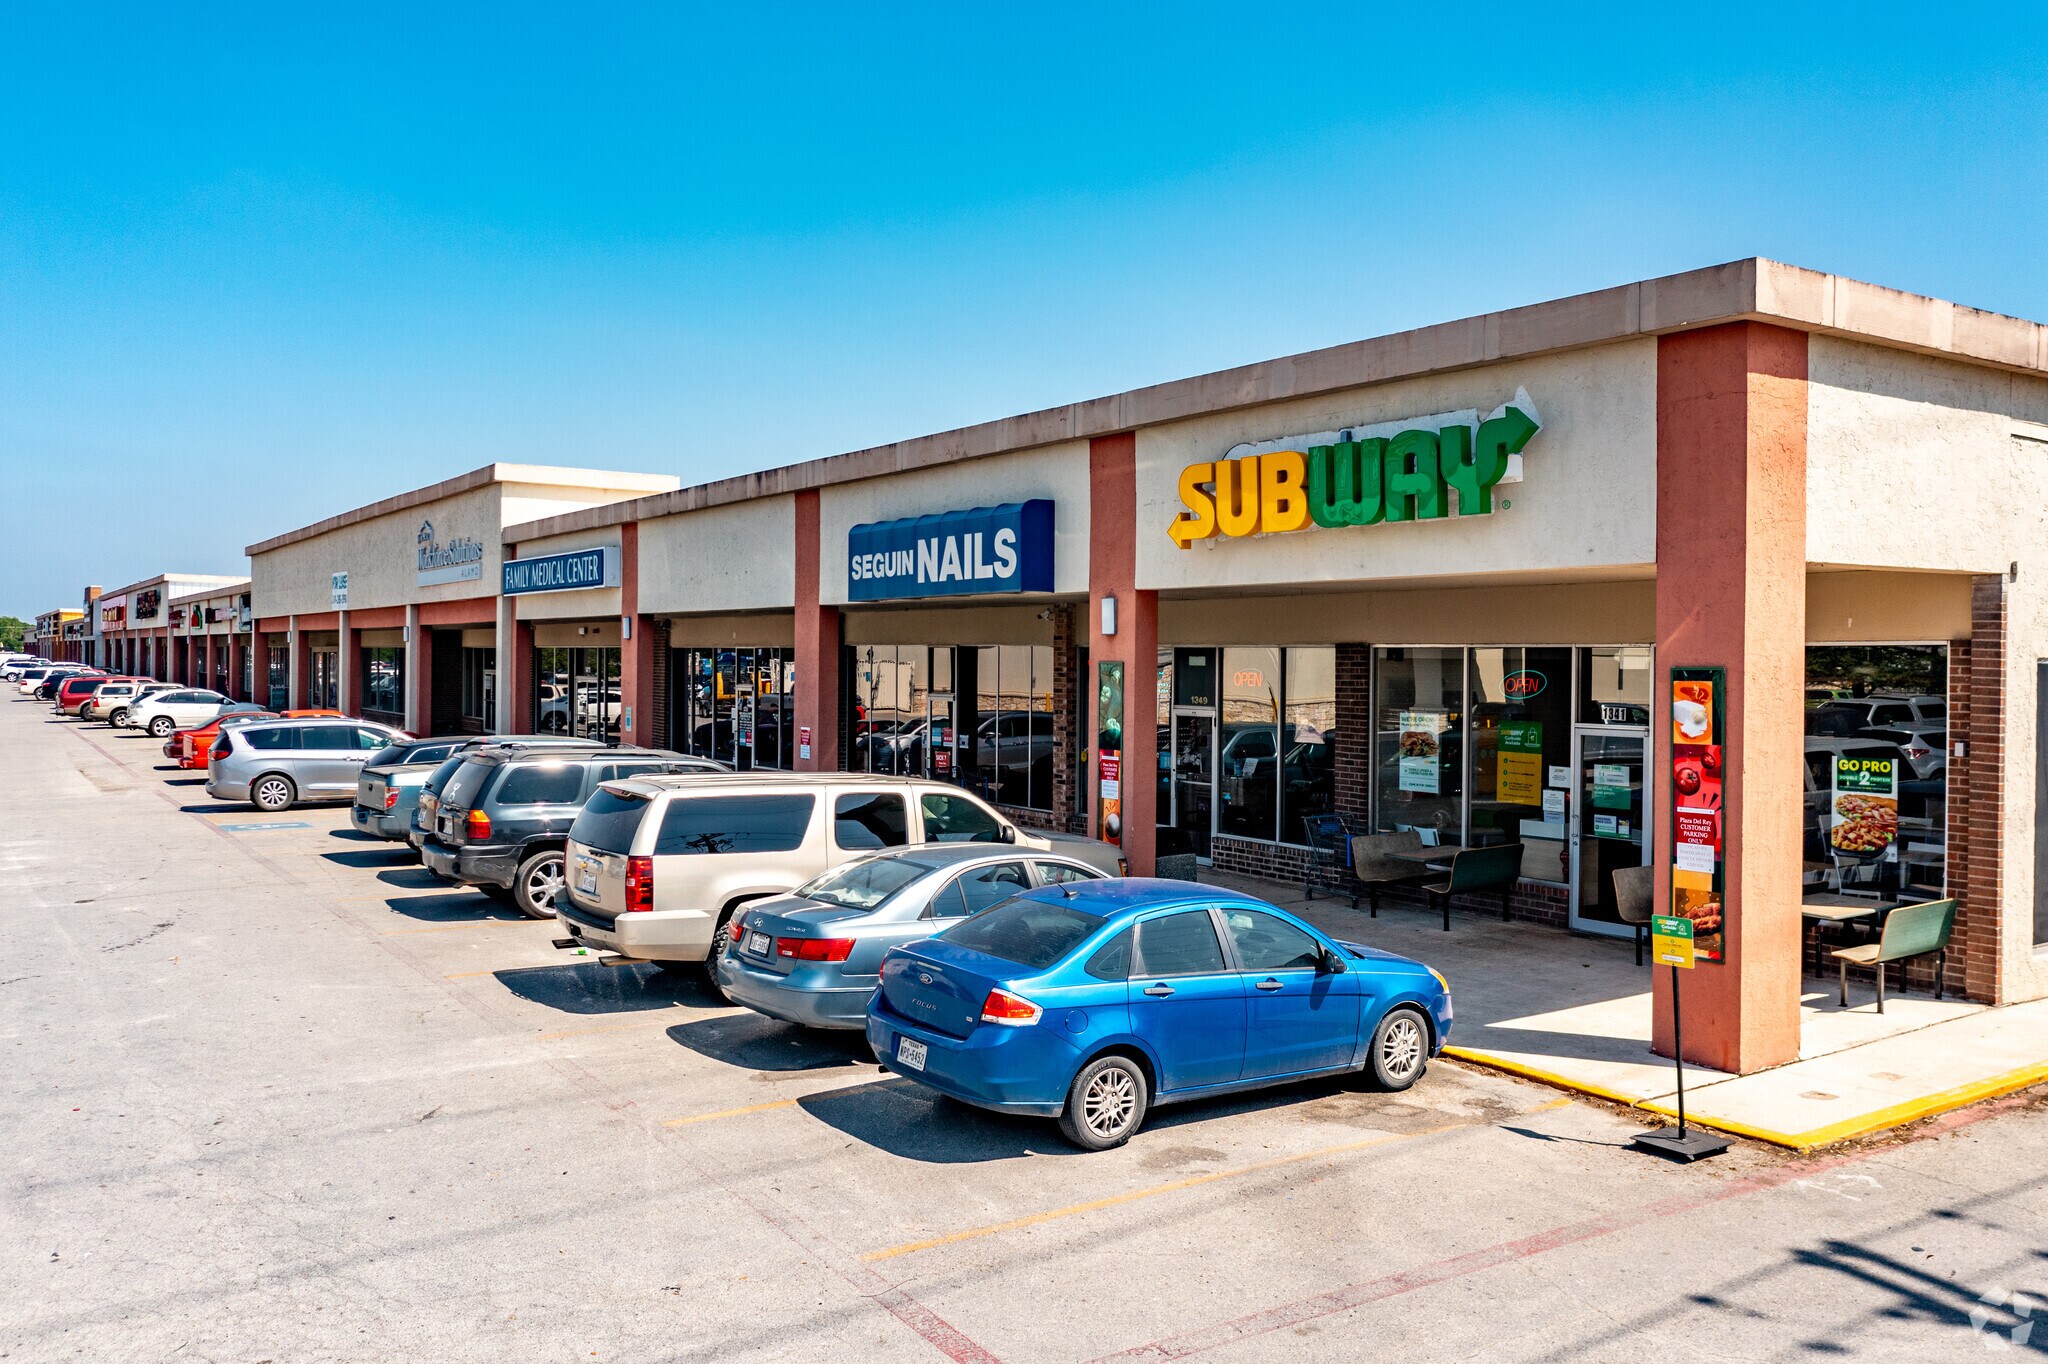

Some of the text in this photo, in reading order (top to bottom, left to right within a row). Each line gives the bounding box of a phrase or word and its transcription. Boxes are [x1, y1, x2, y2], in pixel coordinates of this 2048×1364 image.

[1167, 405, 1540, 550] SUBWAY
[851, 528, 1018, 584] SEGUIN NAILS
[505, 555, 599, 590] FAMILY MEDICAL CENTER
[1233, 671, 1263, 687] OPEN
[1505, 677, 1539, 693] OPEN
[1602, 707, 1626, 721] 1341
[1838, 759, 1891, 773] GO PRO
[1680, 824, 1711, 832] CUSTOMER
[1702, 819, 1712, 827] Rey
[1683, 831, 1708, 839] PARKING
[1657, 918, 1679, 926] SUBWAY
[911, 998, 937, 1011] FOCUS
